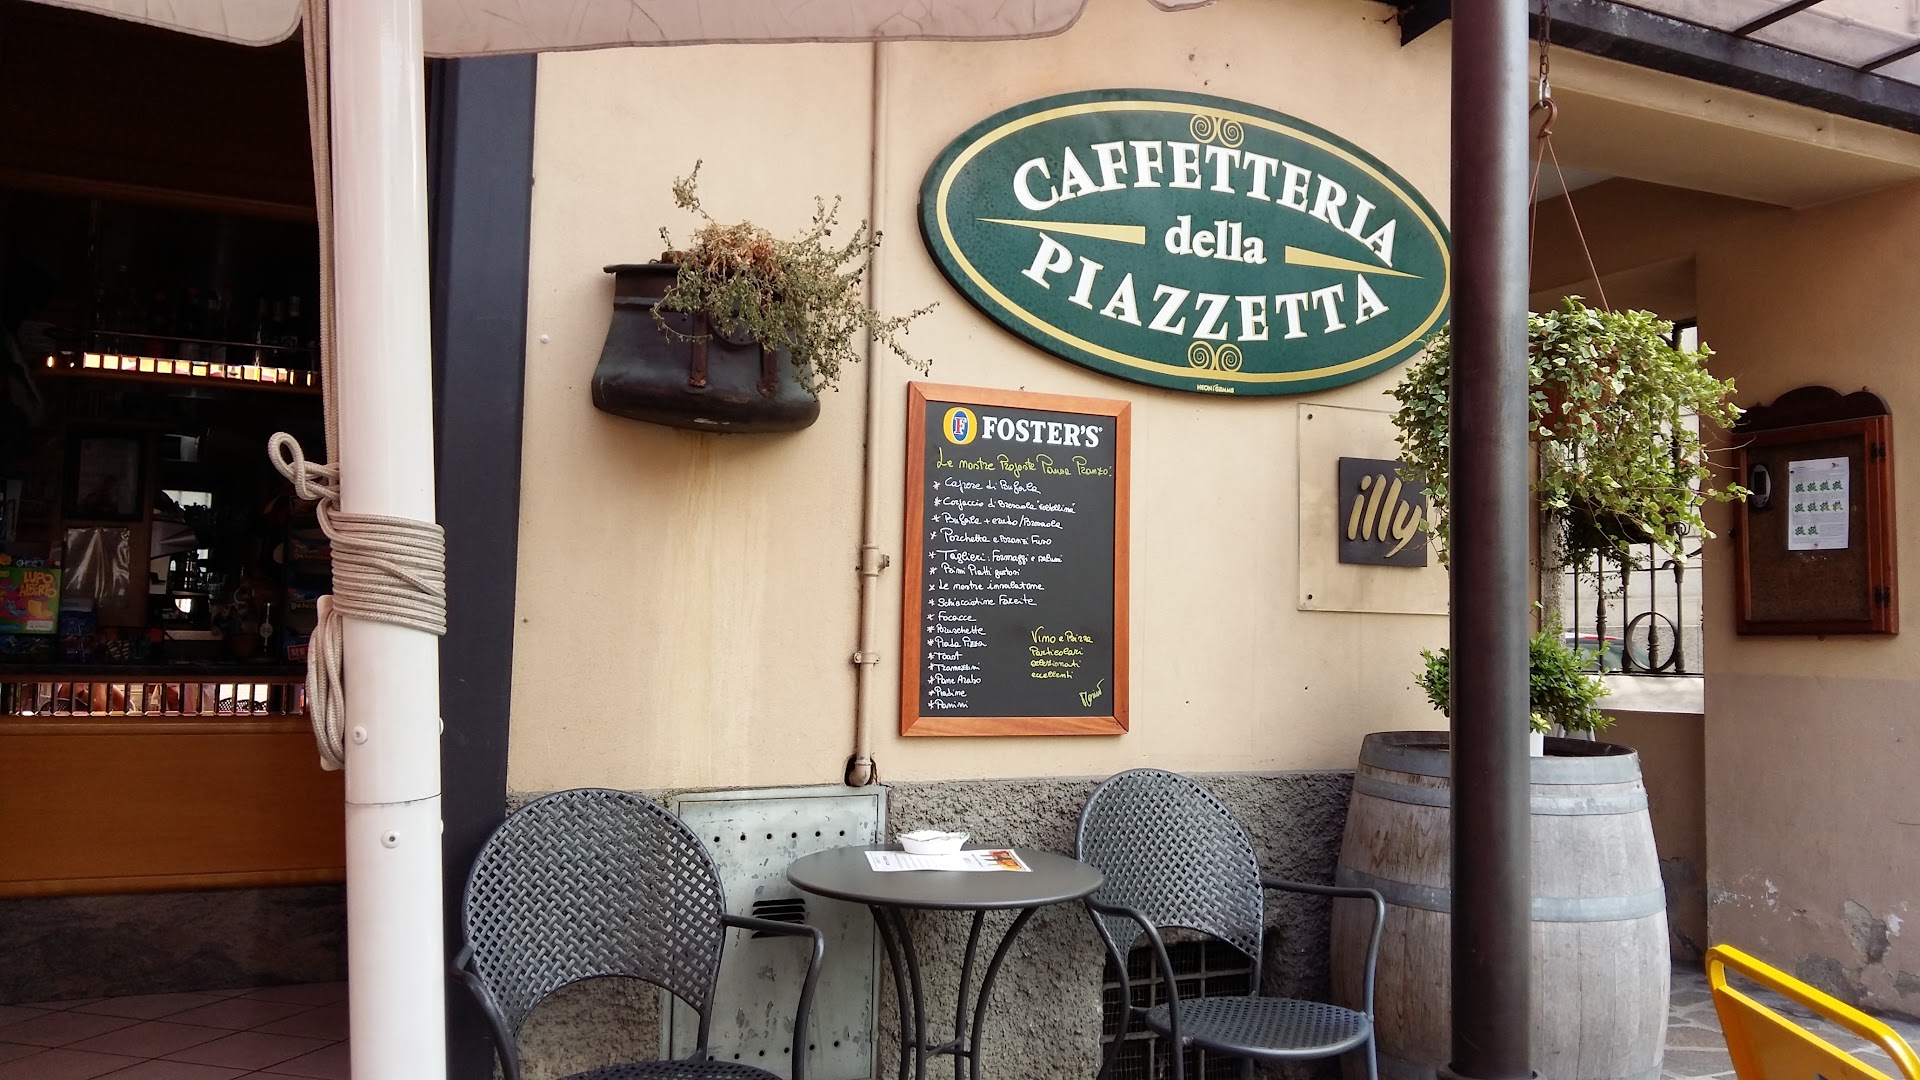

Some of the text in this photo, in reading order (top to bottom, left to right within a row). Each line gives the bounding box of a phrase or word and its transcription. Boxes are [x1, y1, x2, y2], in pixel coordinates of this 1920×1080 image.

[1012, 140, 1399, 267] CAFFETTERIA
[1164, 214, 1267, 264] della
[1021, 232, 1391, 342] PIAZZETTA
[981, 415, 1103, 448] FOSTER'S
[936, 447, 954, 469] Le
[985, 479, 998, 490] di
[1347, 473, 1422, 558] illy
[23, 570, 55, 584] LUPO
[938, 578, 950, 590] Le
[18, 582, 57, 600] ALBERTO
[937, 610, 977, 622] Focacce
[1030, 625, 1057, 644] Vino
[933, 650, 963, 661] Toast
[1028, 645, 1084, 657] Particolari
[934, 673, 982, 684] Pane Arabo
[1030, 670, 1074, 679] eccellenti
[934, 685, 967, 697] Piadine
[934, 698, 969, 710] Panini
